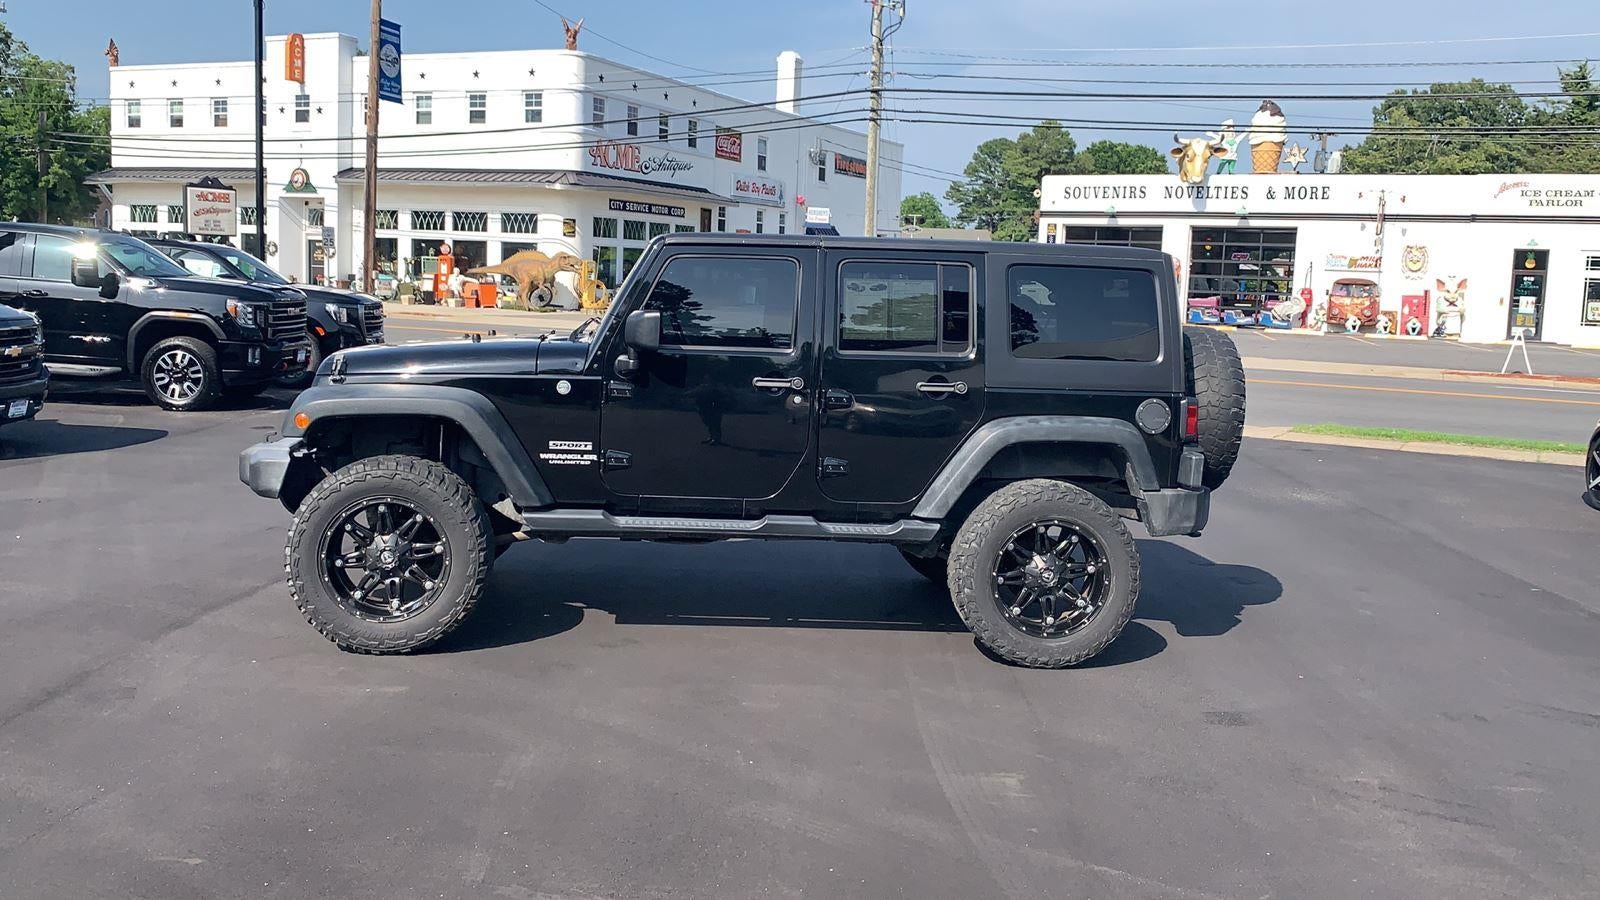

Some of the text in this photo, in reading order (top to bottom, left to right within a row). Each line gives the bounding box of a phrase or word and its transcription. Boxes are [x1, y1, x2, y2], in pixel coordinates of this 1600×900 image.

[588, 138, 641, 173] ACME
[751, 182, 761, 197] Boy
[1063, 185, 1331, 200] SOUVENIRS NOVELTIES & MORE
[1520, 189, 1541, 197] ICE
[1545, 189, 1595, 198] CREAM
[610, 200, 624, 210] CITY
[625, 202, 649, 213] SERVICE
[651, 205, 669, 215] MOTOR
[1528, 199, 1583, 207] PARLOR
[323, 237, 335, 247] 25
[539, 453, 598, 461] WRANGLER
